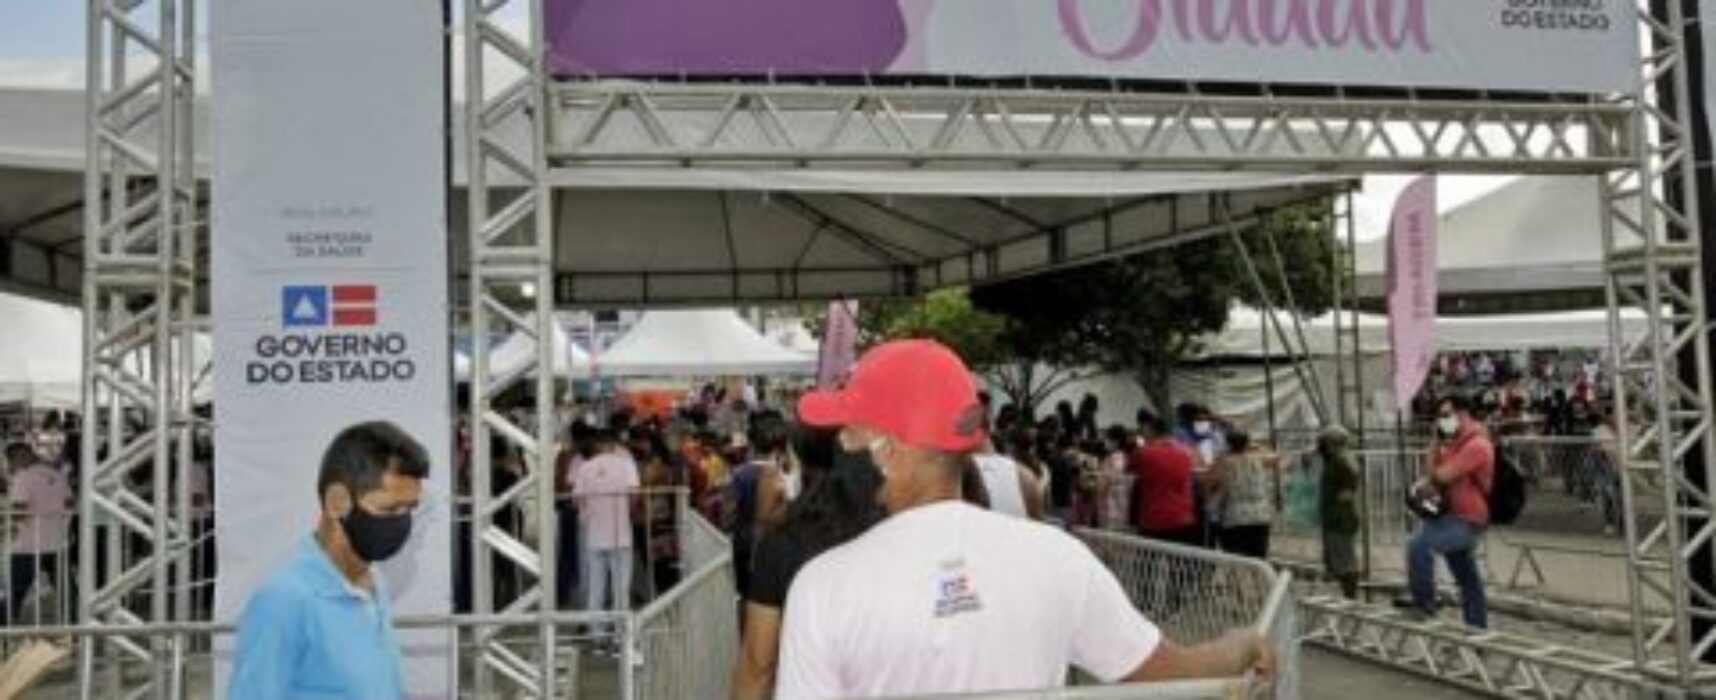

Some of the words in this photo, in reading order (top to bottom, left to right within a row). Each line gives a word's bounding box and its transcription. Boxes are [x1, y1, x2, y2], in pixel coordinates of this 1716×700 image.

[1501, 10, 1531, 28] DO
[1533, 10, 1609, 29] ESTADO
[256, 333, 407, 357] GOVERNO
[246, 361, 294, 383] DO
[299, 359, 415, 382] ESTADO
